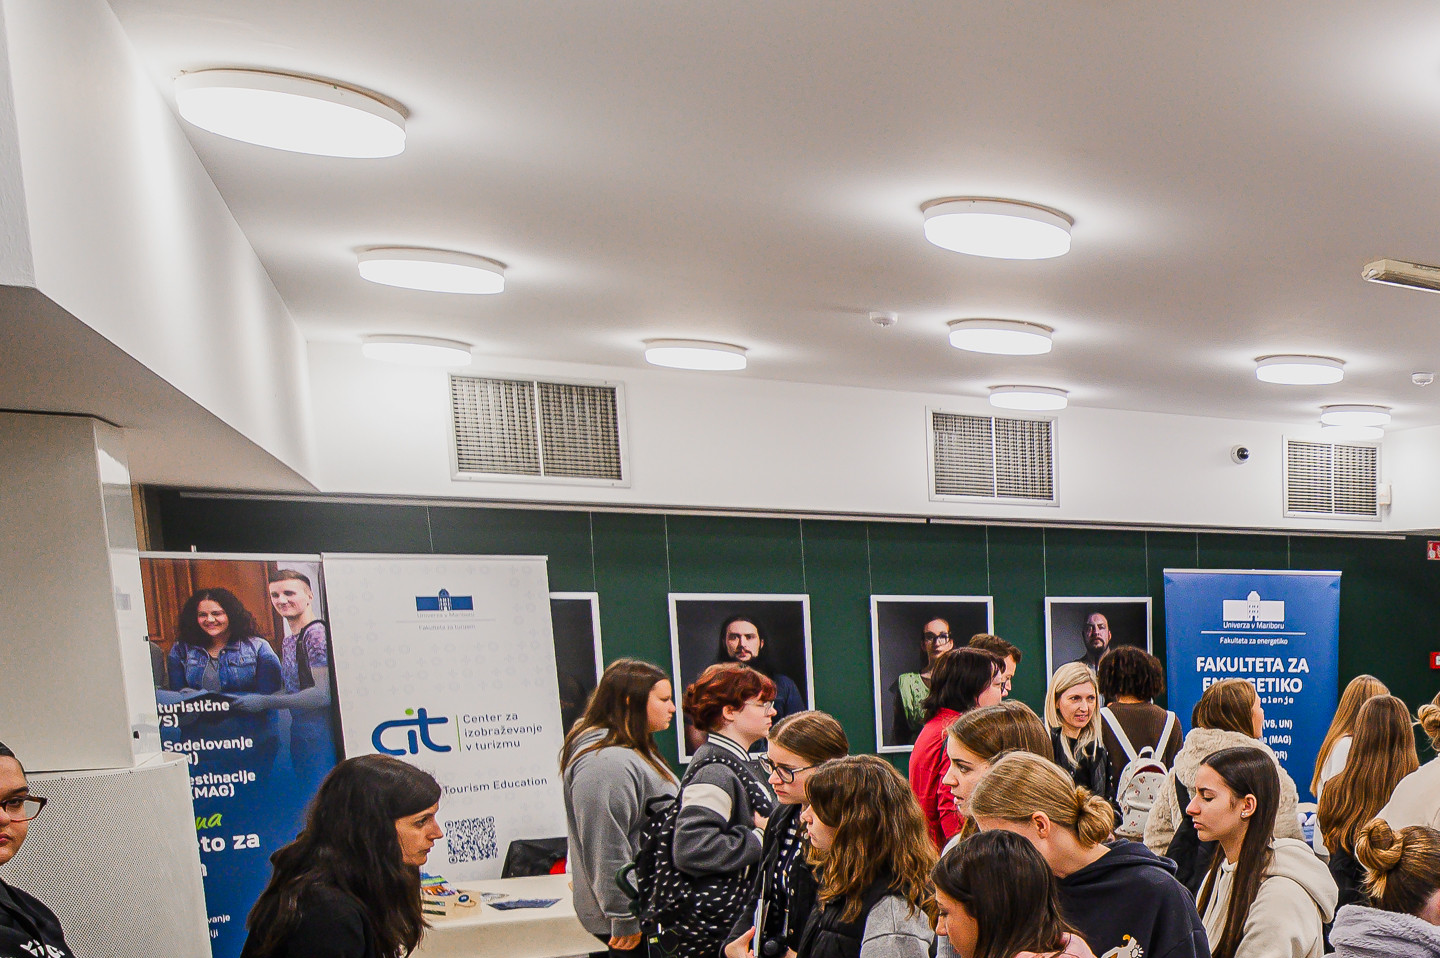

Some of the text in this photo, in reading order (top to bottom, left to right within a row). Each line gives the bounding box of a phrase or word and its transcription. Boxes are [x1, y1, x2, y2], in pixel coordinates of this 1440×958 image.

[1223, 621, 1250, 629] Univerza
[1257, 637, 1288, 646] energetiko
[1196, 656, 1309, 673] FAKULTETA ZA
[1202, 677, 1303, 693] EGETIKO
[157, 699, 230, 714] turistične
[463, 712, 518, 724] Center za
[464, 724, 543, 738] izobraževanje
[163, 735, 253, 752] Sodelovanje
[475, 740, 521, 750] turizmu
[1269, 735, 1292, 745] (MAG)
[442, 776, 548, 795] Tourism Education
[232, 833, 260, 849] za
